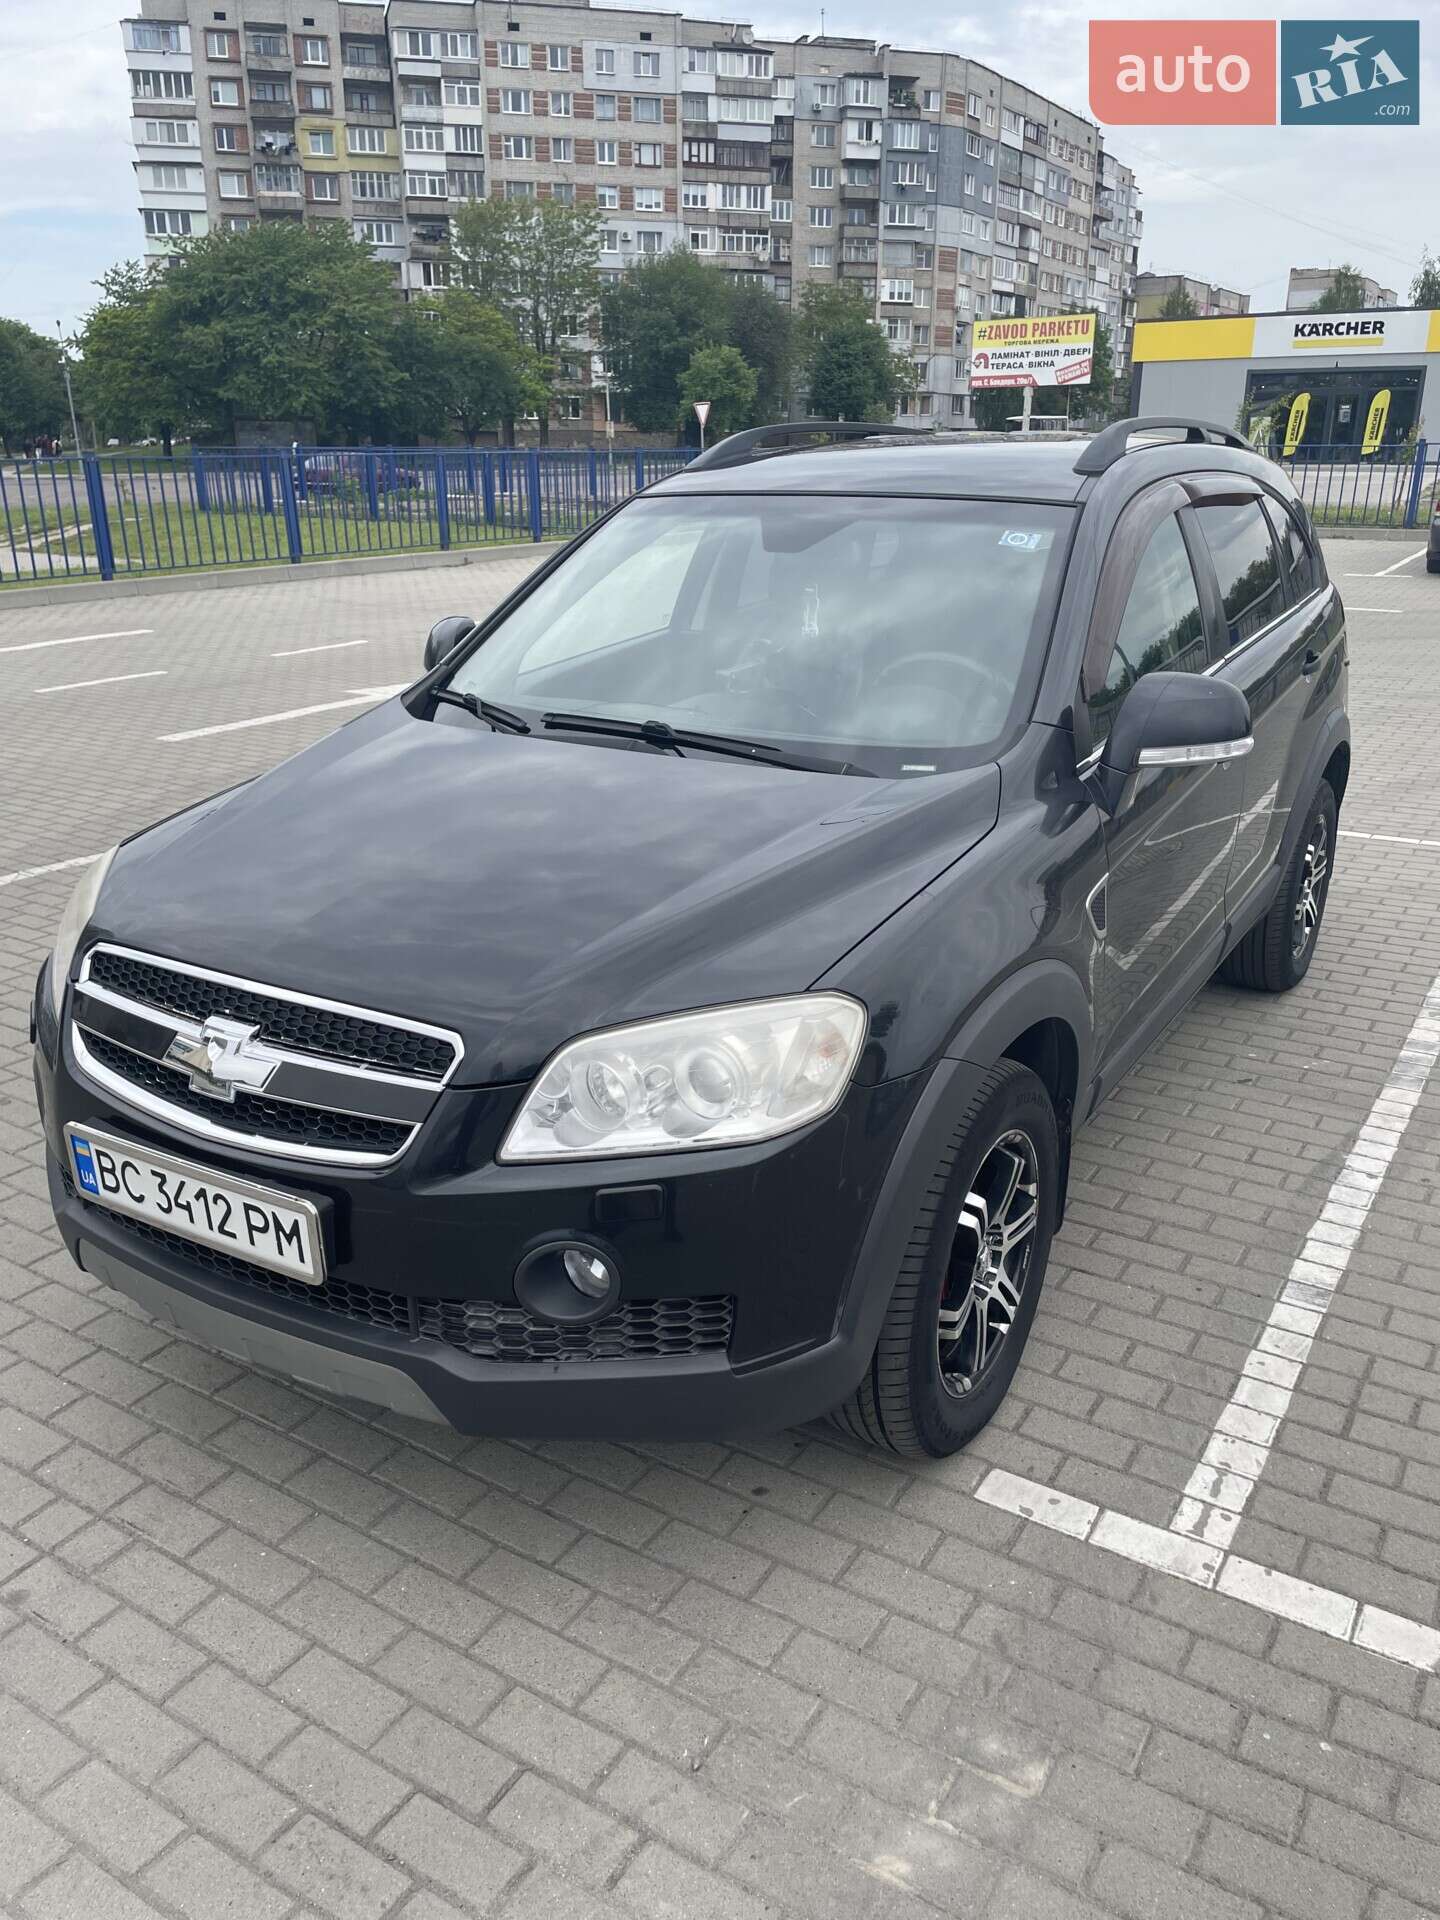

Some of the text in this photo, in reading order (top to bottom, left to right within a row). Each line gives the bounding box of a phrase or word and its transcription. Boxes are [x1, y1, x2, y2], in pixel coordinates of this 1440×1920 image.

[978, 319, 1090, 340] #ZAVOD PARKETU
[1294, 320, 1385, 337] KÄRCHER
[990, 348, 1091, 360] ЛАМІНАТ ВІНІЛ ДВЕРІ
[991, 360, 1055, 370] ТЕРАСА ВІКНА
[81, 1169, 96, 1186] UA
[95, 1148, 306, 1264] BC 3412 PM
